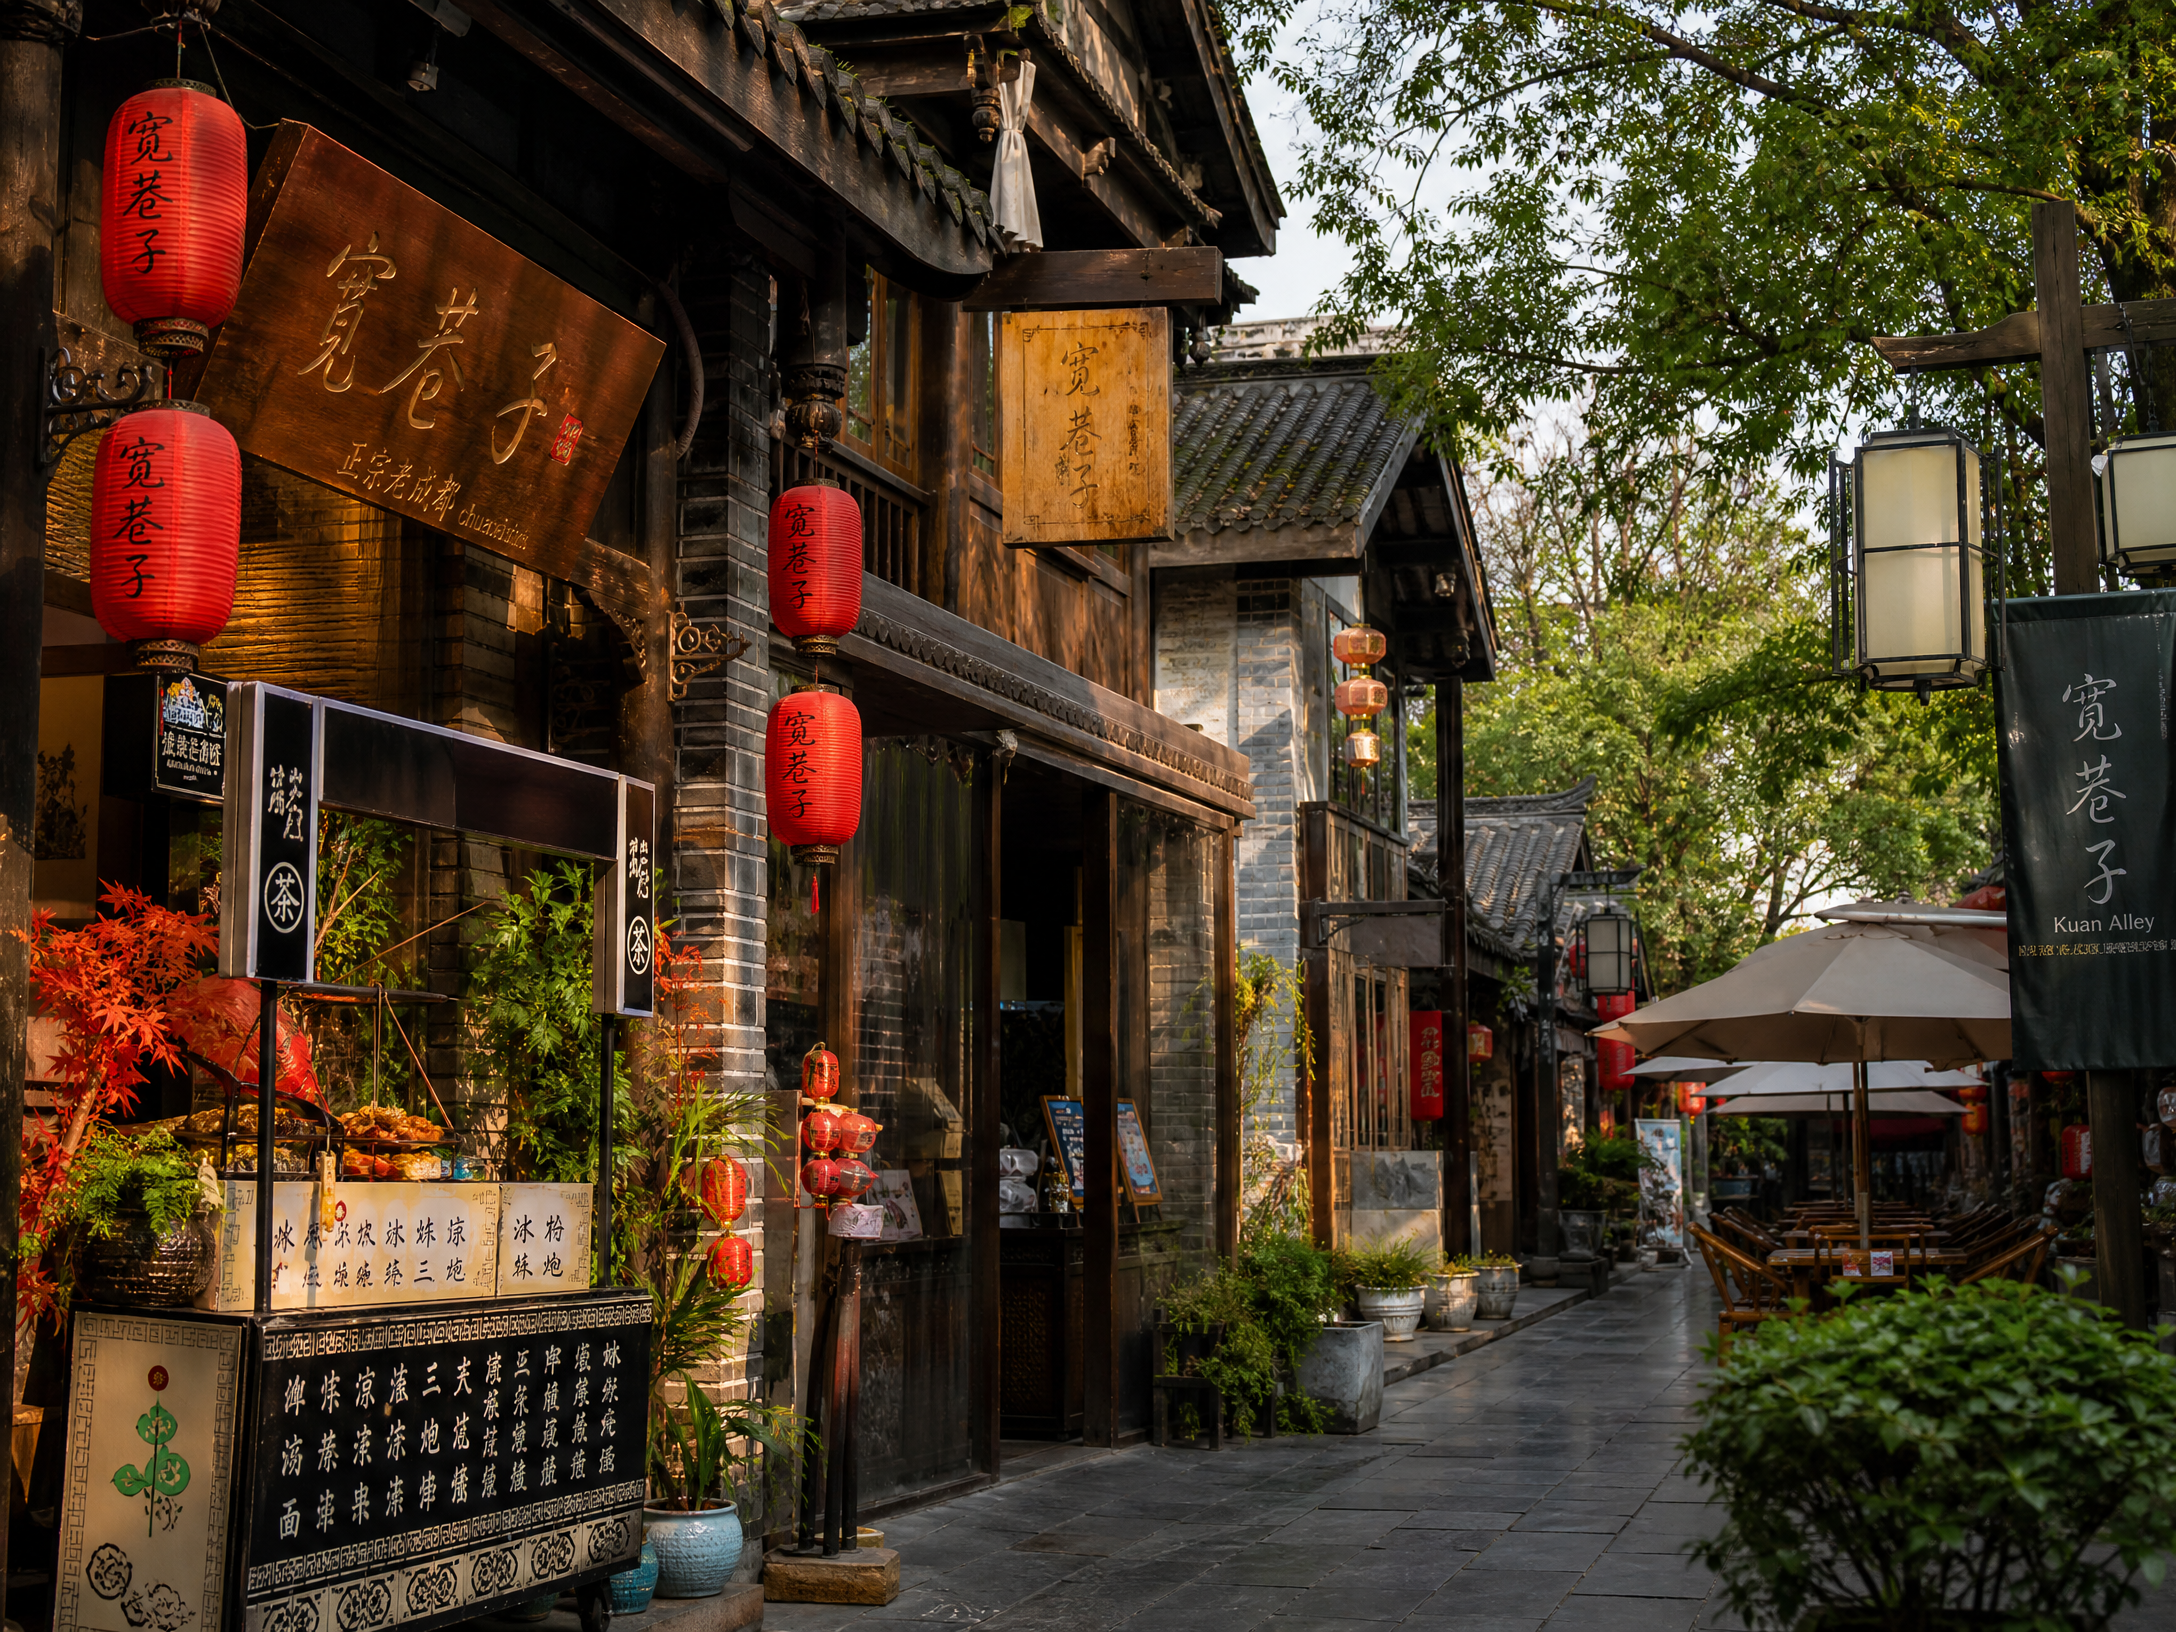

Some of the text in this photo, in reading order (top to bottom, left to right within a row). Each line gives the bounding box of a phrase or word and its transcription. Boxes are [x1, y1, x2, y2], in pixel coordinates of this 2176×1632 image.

[337, 441, 461, 521] 正宗老成都
[270, 872, 300, 922] 茶
[631, 926, 648, 966] 茶
[2054, 913, 2155, 934] Kuan Alley
